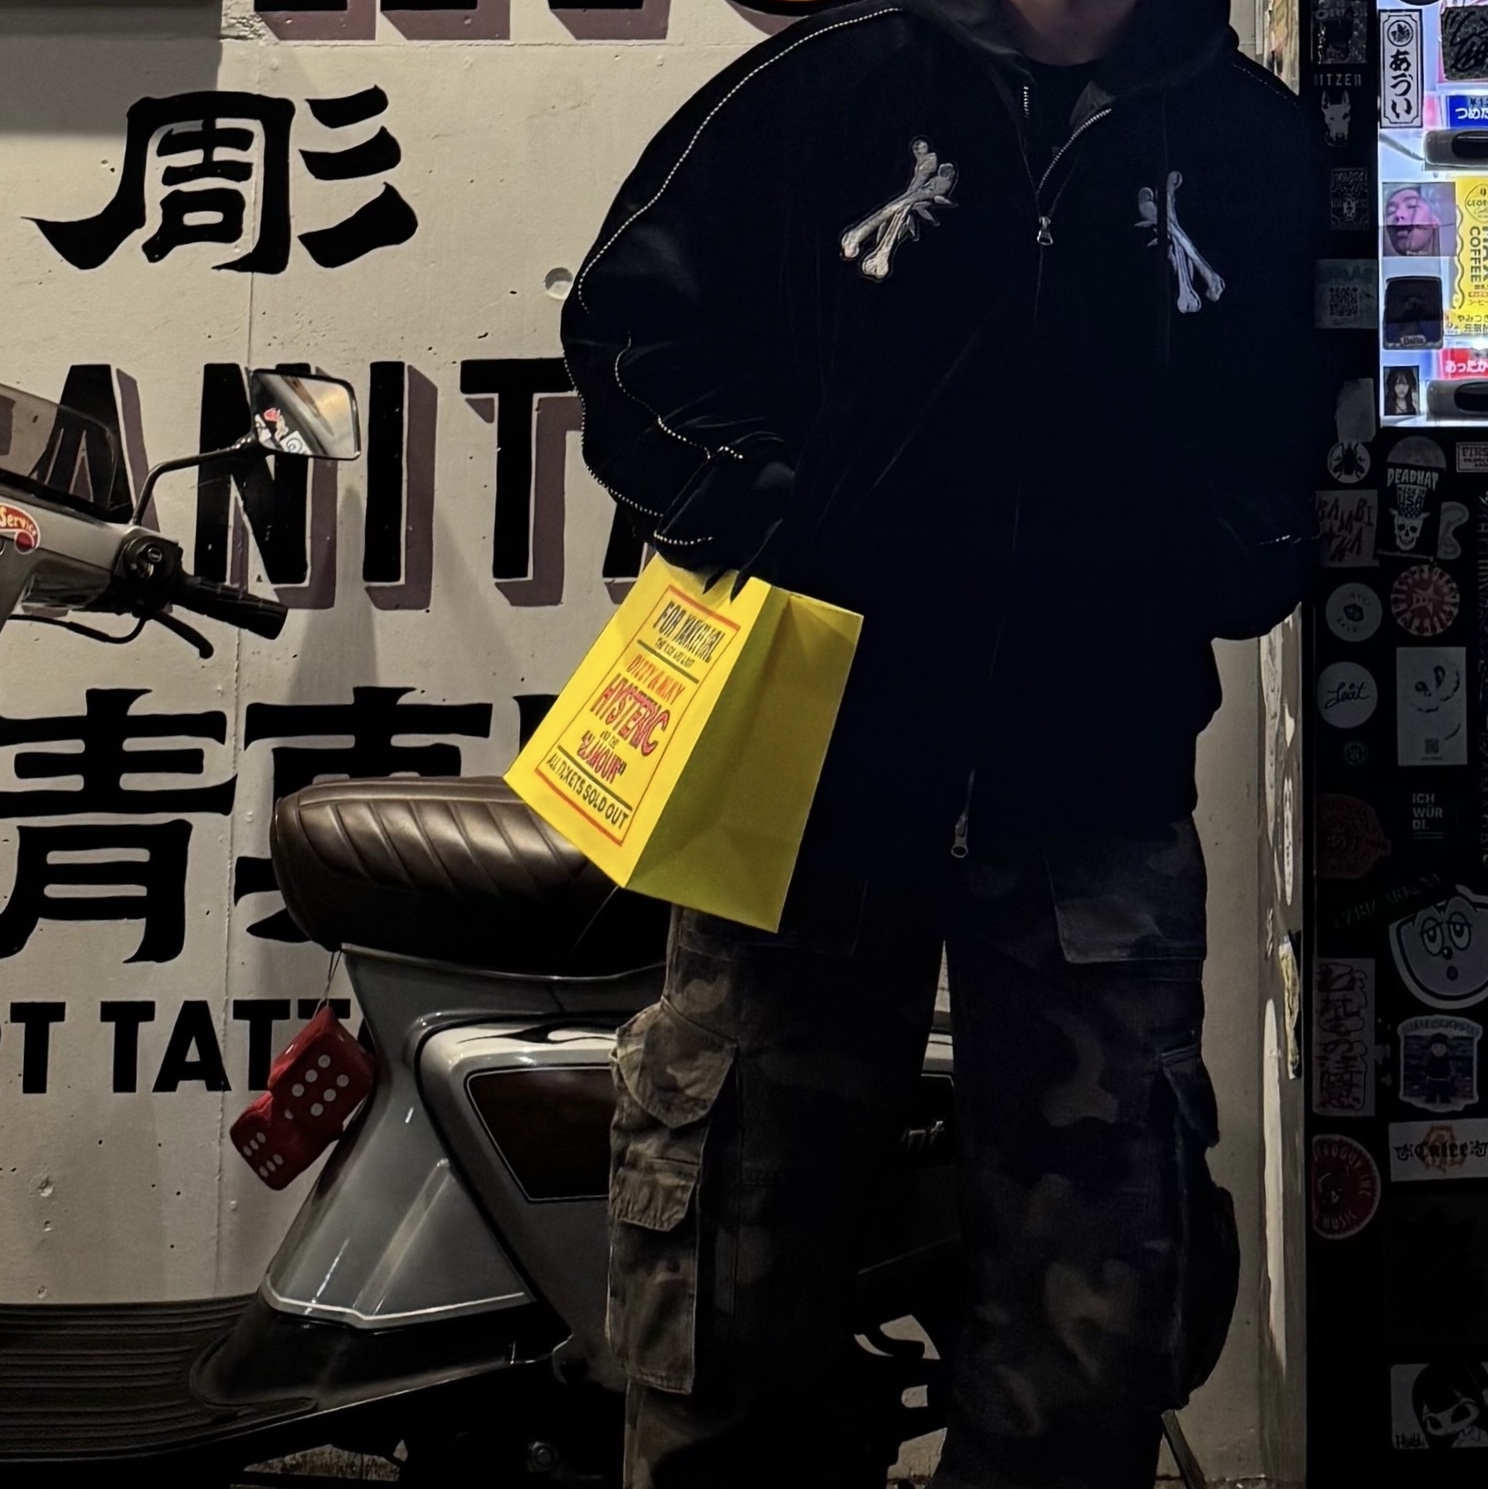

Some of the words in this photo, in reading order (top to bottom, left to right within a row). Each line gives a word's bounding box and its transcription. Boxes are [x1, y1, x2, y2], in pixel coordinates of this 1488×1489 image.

[22, 84, 418, 274] 彫
[1469, 225, 1482, 283] COFFEE
[28, 360, 665, 584] ANIT
[1386, 467, 1439, 489] DEADHAT
[604, 805, 630, 830] OUT
[0, 1001, 66, 1093] T
